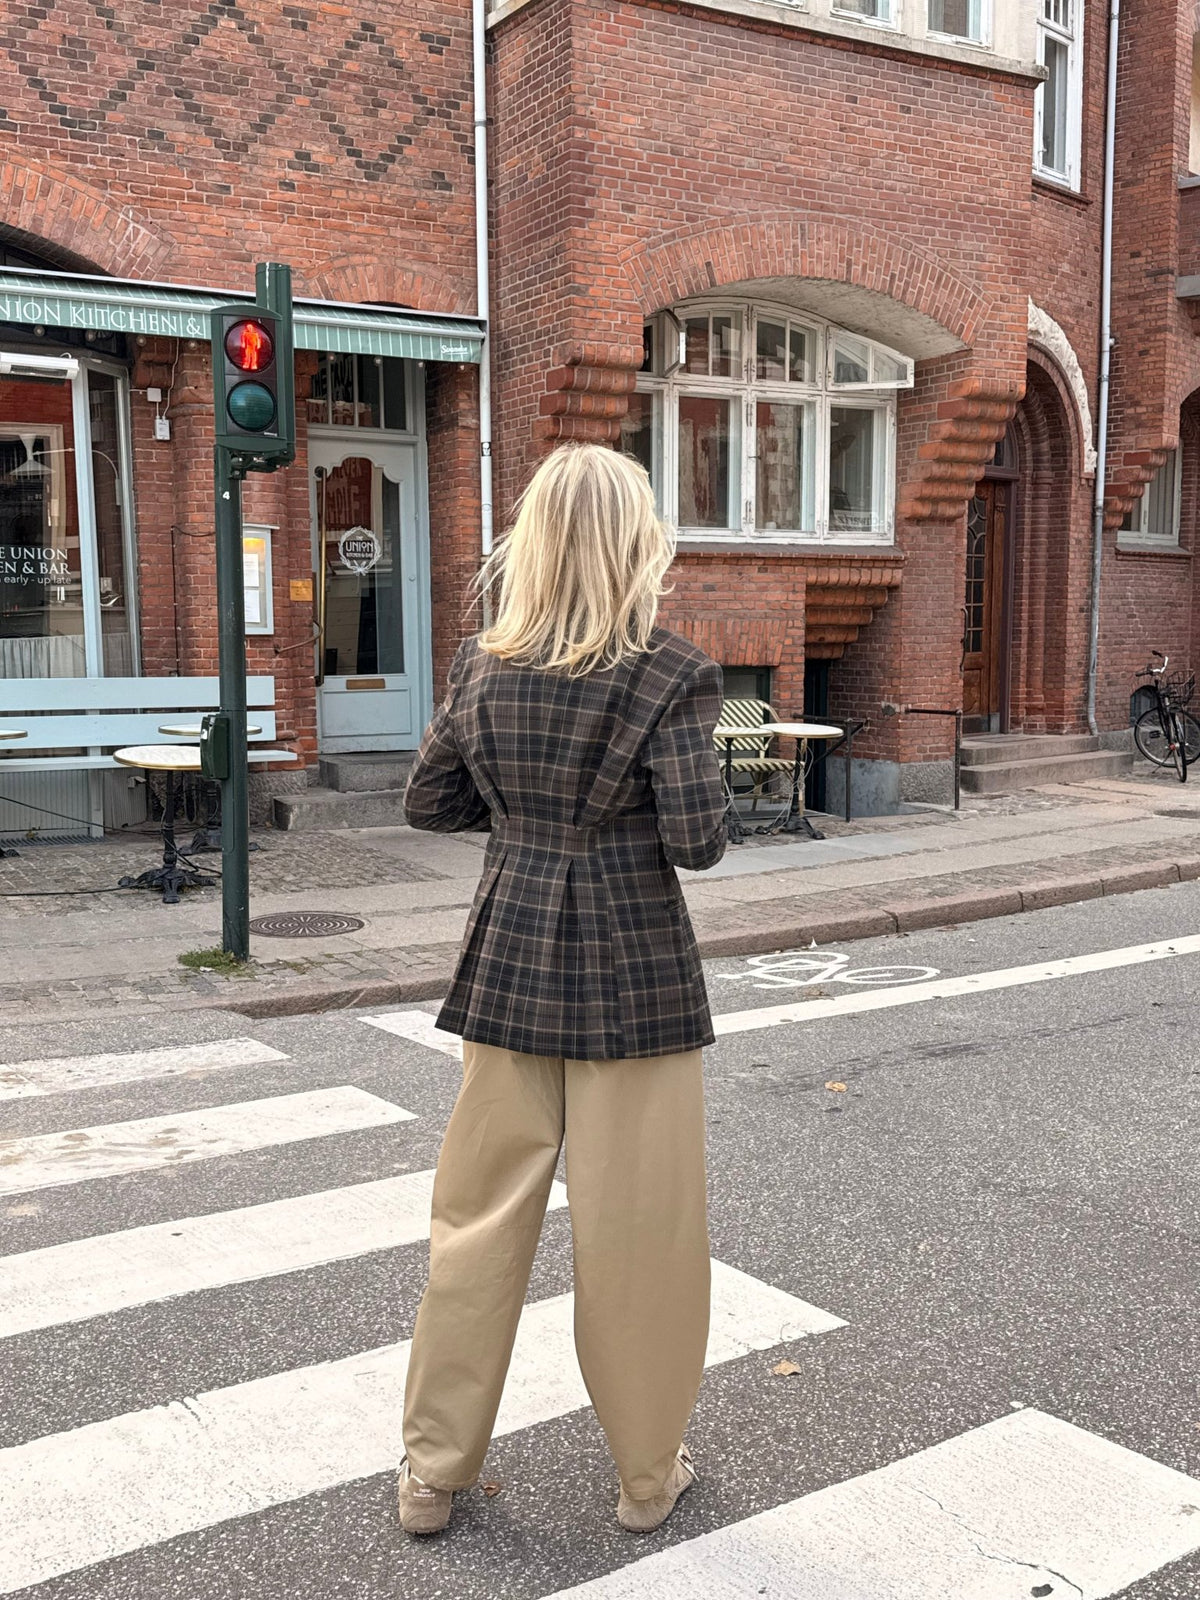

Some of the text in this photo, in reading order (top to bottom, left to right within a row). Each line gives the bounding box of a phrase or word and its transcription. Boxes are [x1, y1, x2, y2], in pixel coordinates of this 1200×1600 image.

[71, 306, 178, 333] KITCHEN
[186, 317, 204, 336] &
[345, 541, 374, 552] UNION
[10, 547, 68, 560] UNION
[22, 561, 36, 574] &
[40, 562, 71, 575] BAR
[3, 574, 29, 585] early
[37, 577, 51, 586] up
[53, 575, 72, 585] late
